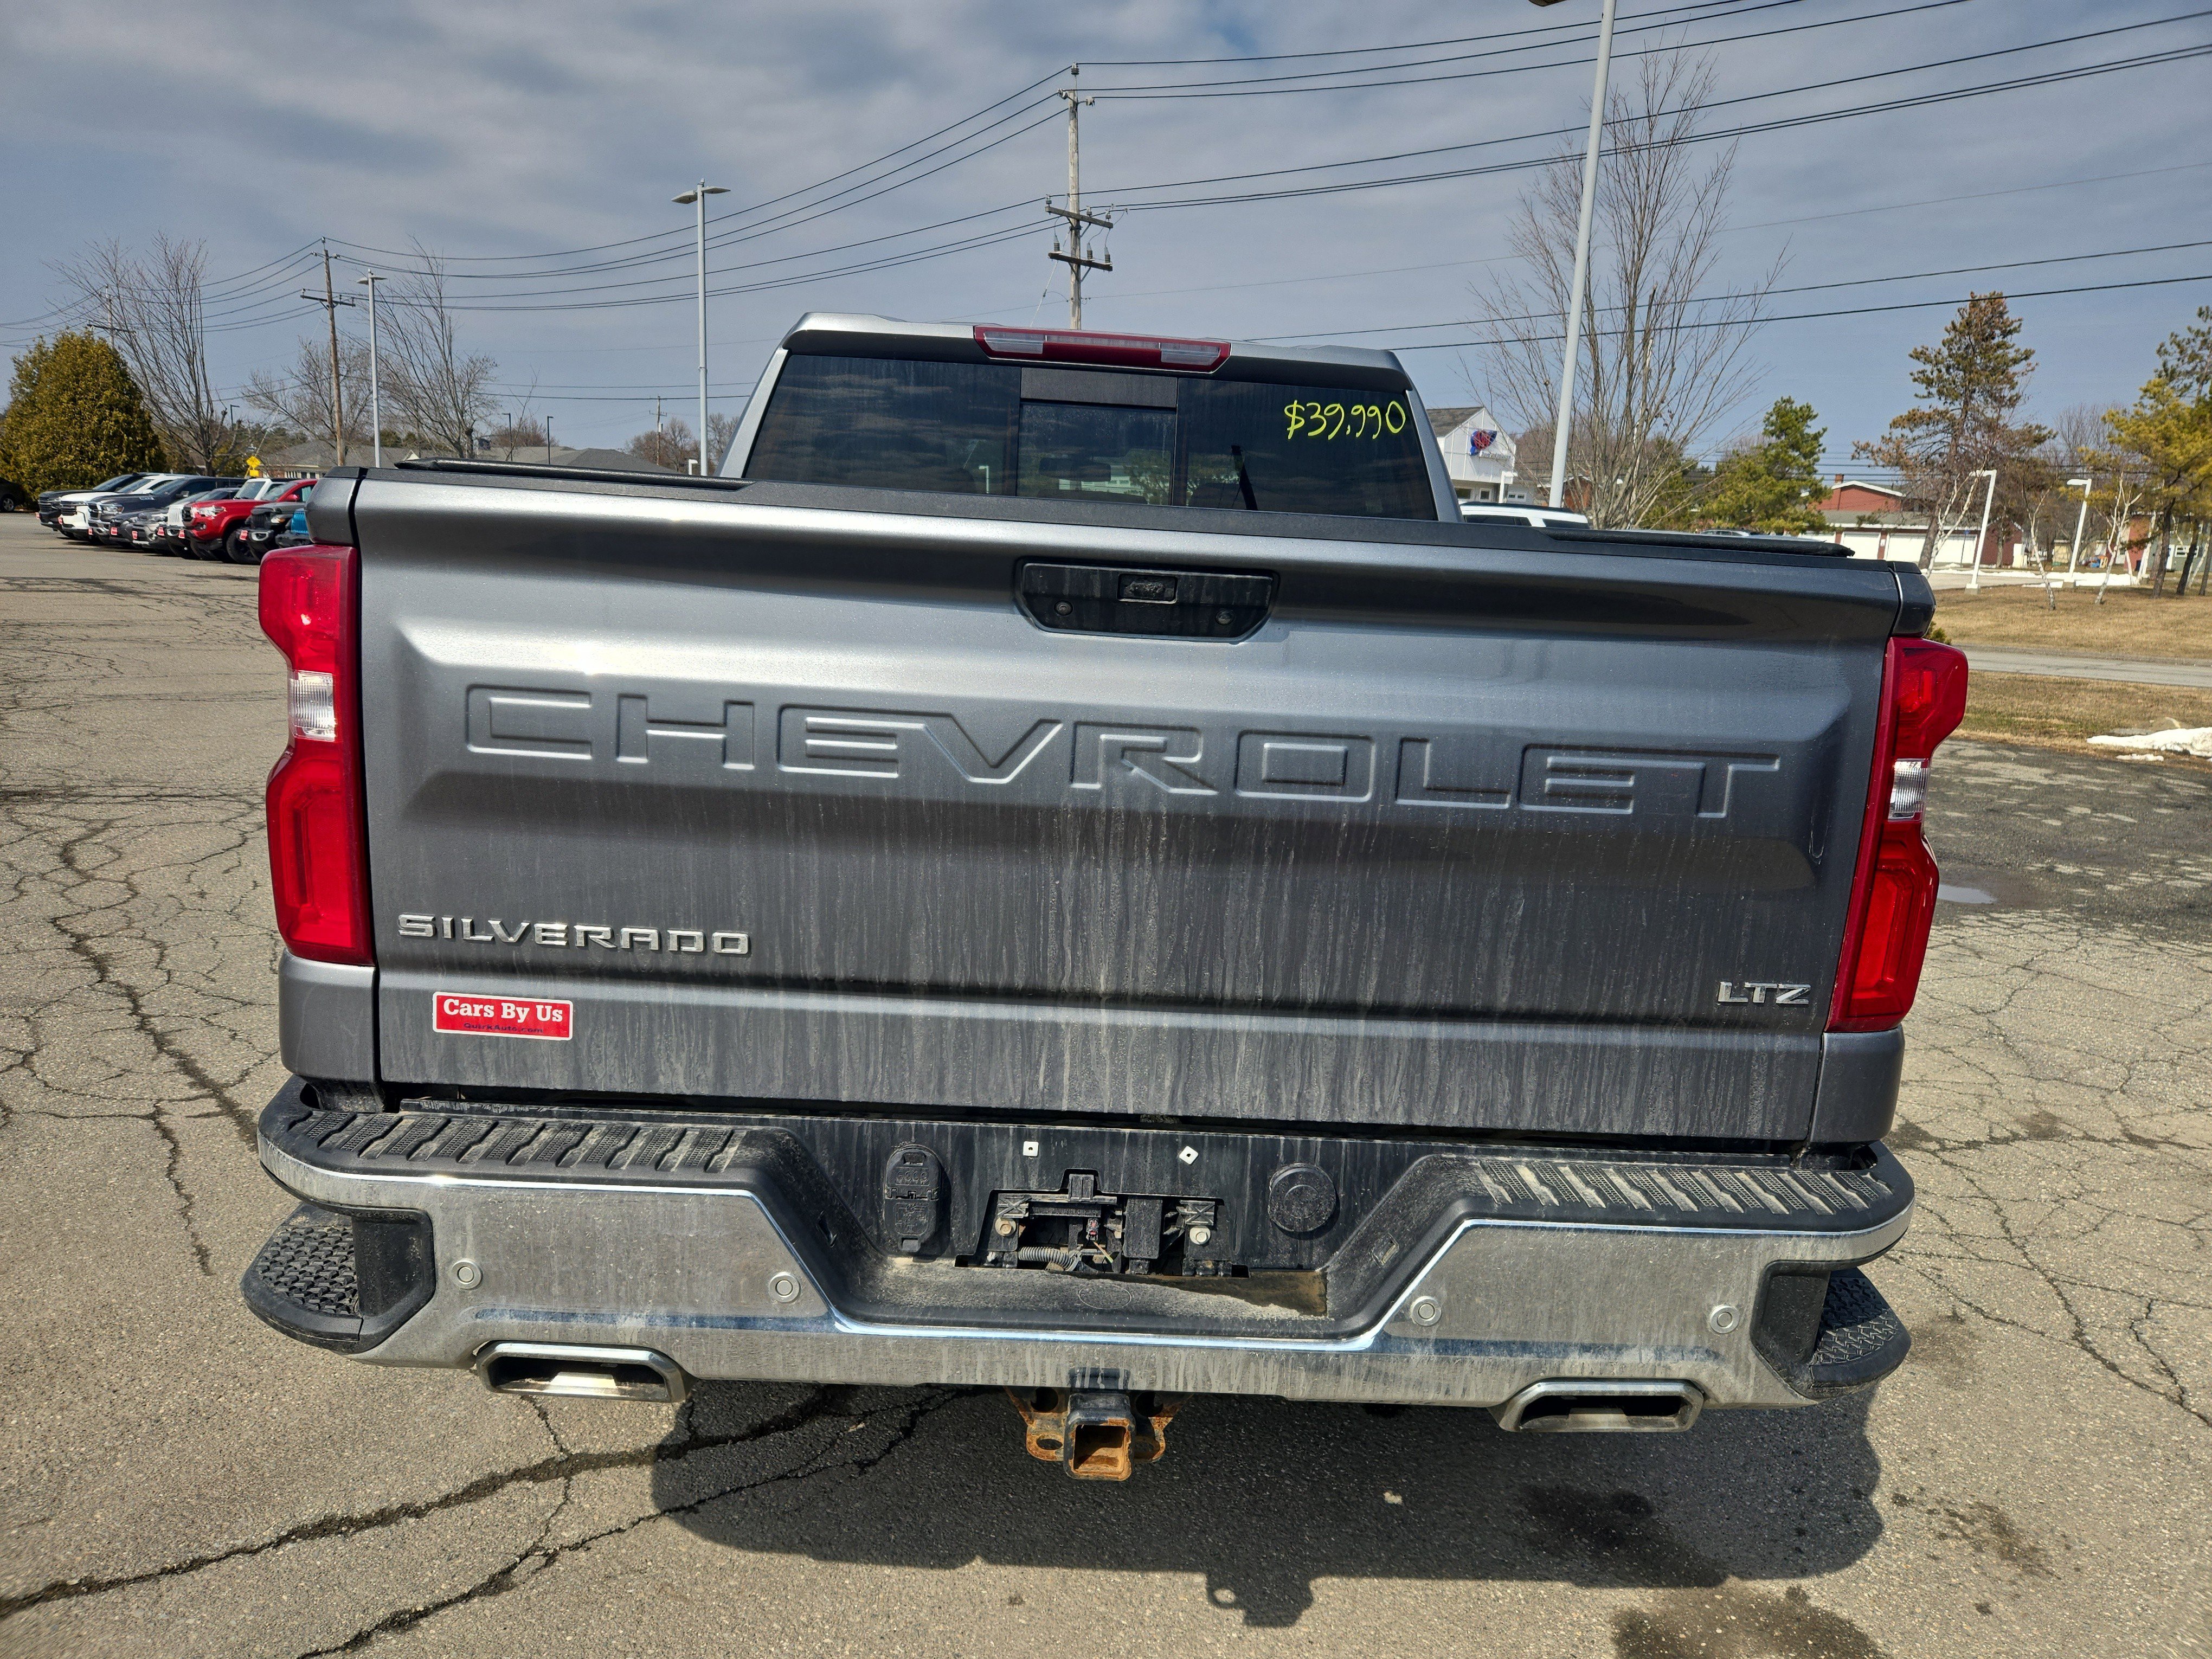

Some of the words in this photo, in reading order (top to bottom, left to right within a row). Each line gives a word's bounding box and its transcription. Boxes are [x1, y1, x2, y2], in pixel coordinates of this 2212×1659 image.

[466, 684, 1780, 819] CHEVROLET
[398, 913, 750, 955] SILVERADO
[1718, 981, 1811, 1004] LTZ
[443, 998, 494, 1018] Cars
[500, 1002, 530, 1023] By
[536, 1005, 563, 1022] Us
[464, 1023, 543, 1033] QuirkAuto.com
